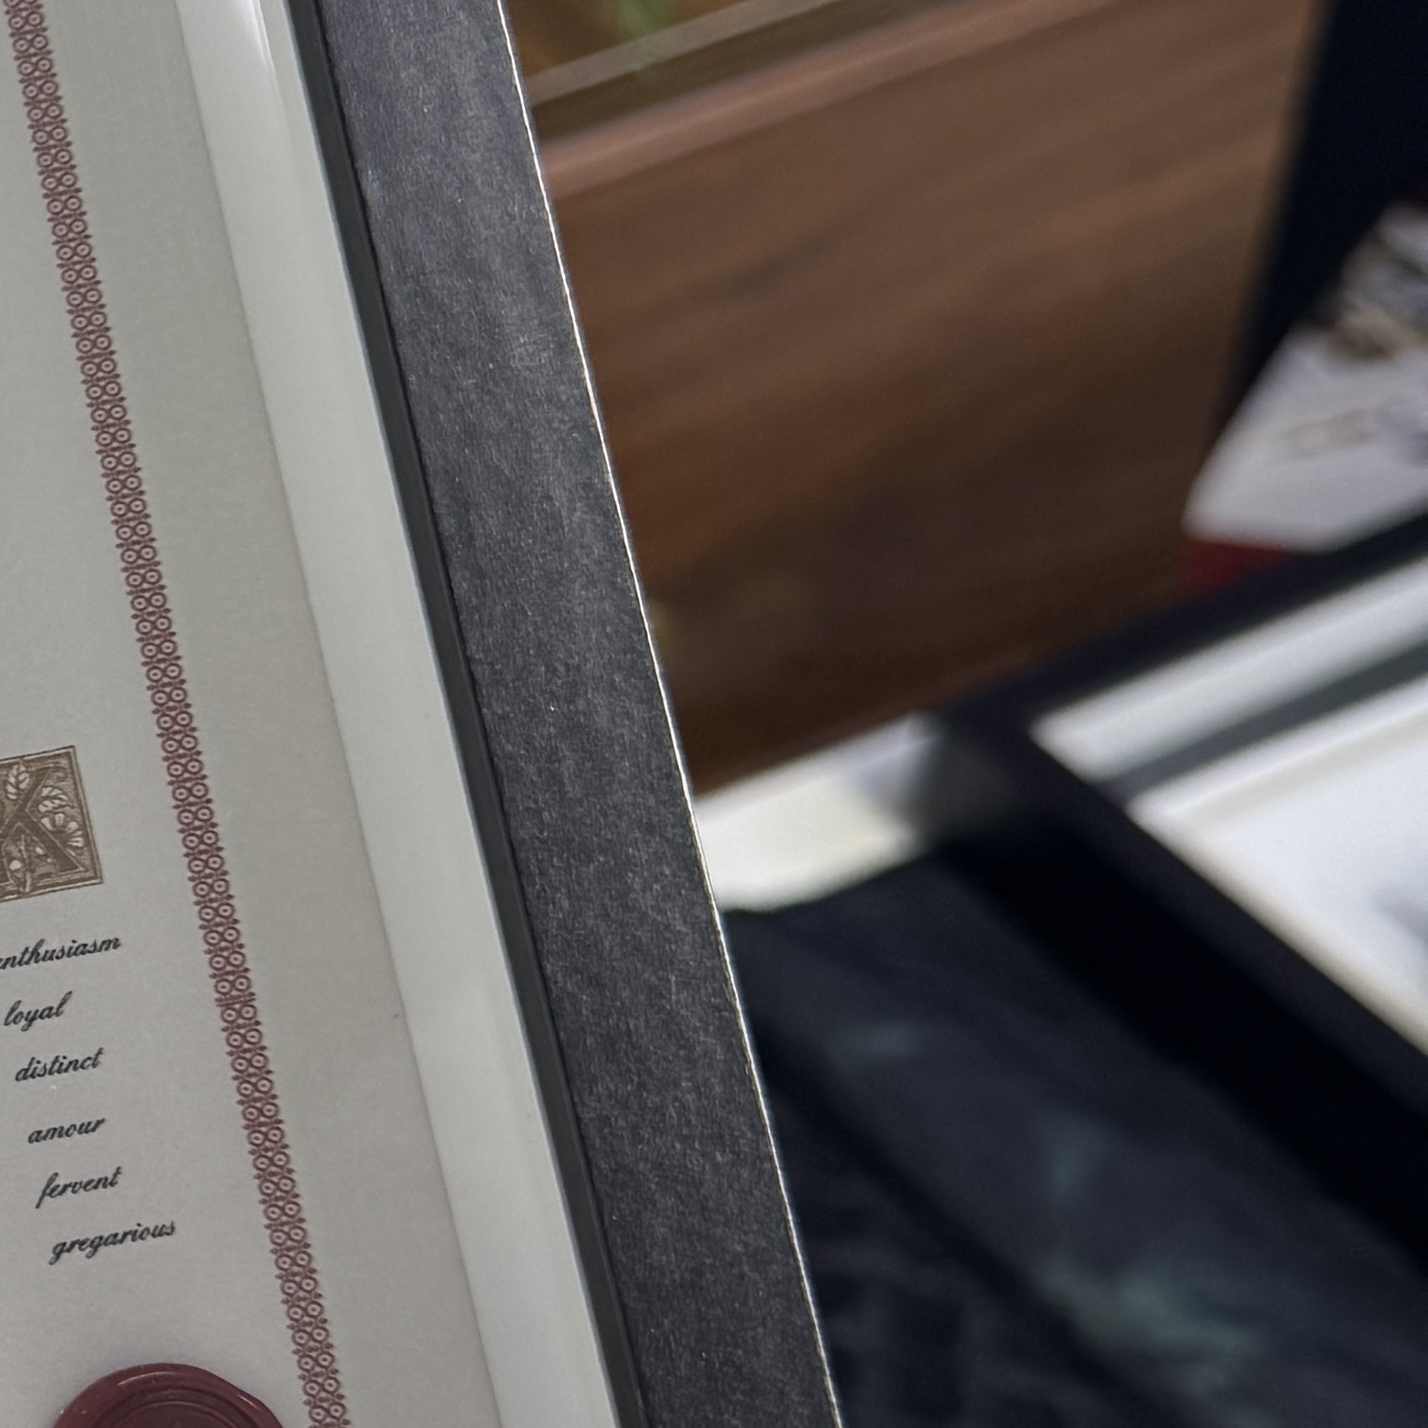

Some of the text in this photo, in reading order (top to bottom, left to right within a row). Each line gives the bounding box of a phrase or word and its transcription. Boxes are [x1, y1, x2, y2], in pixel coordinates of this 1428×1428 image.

[3, 990, 74, 1033] loyal
[14, 1046, 105, 1083] distinct
[27, 1117, 107, 1145] amour
[34, 1165, 123, 1210] fervent
[47, 1220, 177, 1266] gregarious
